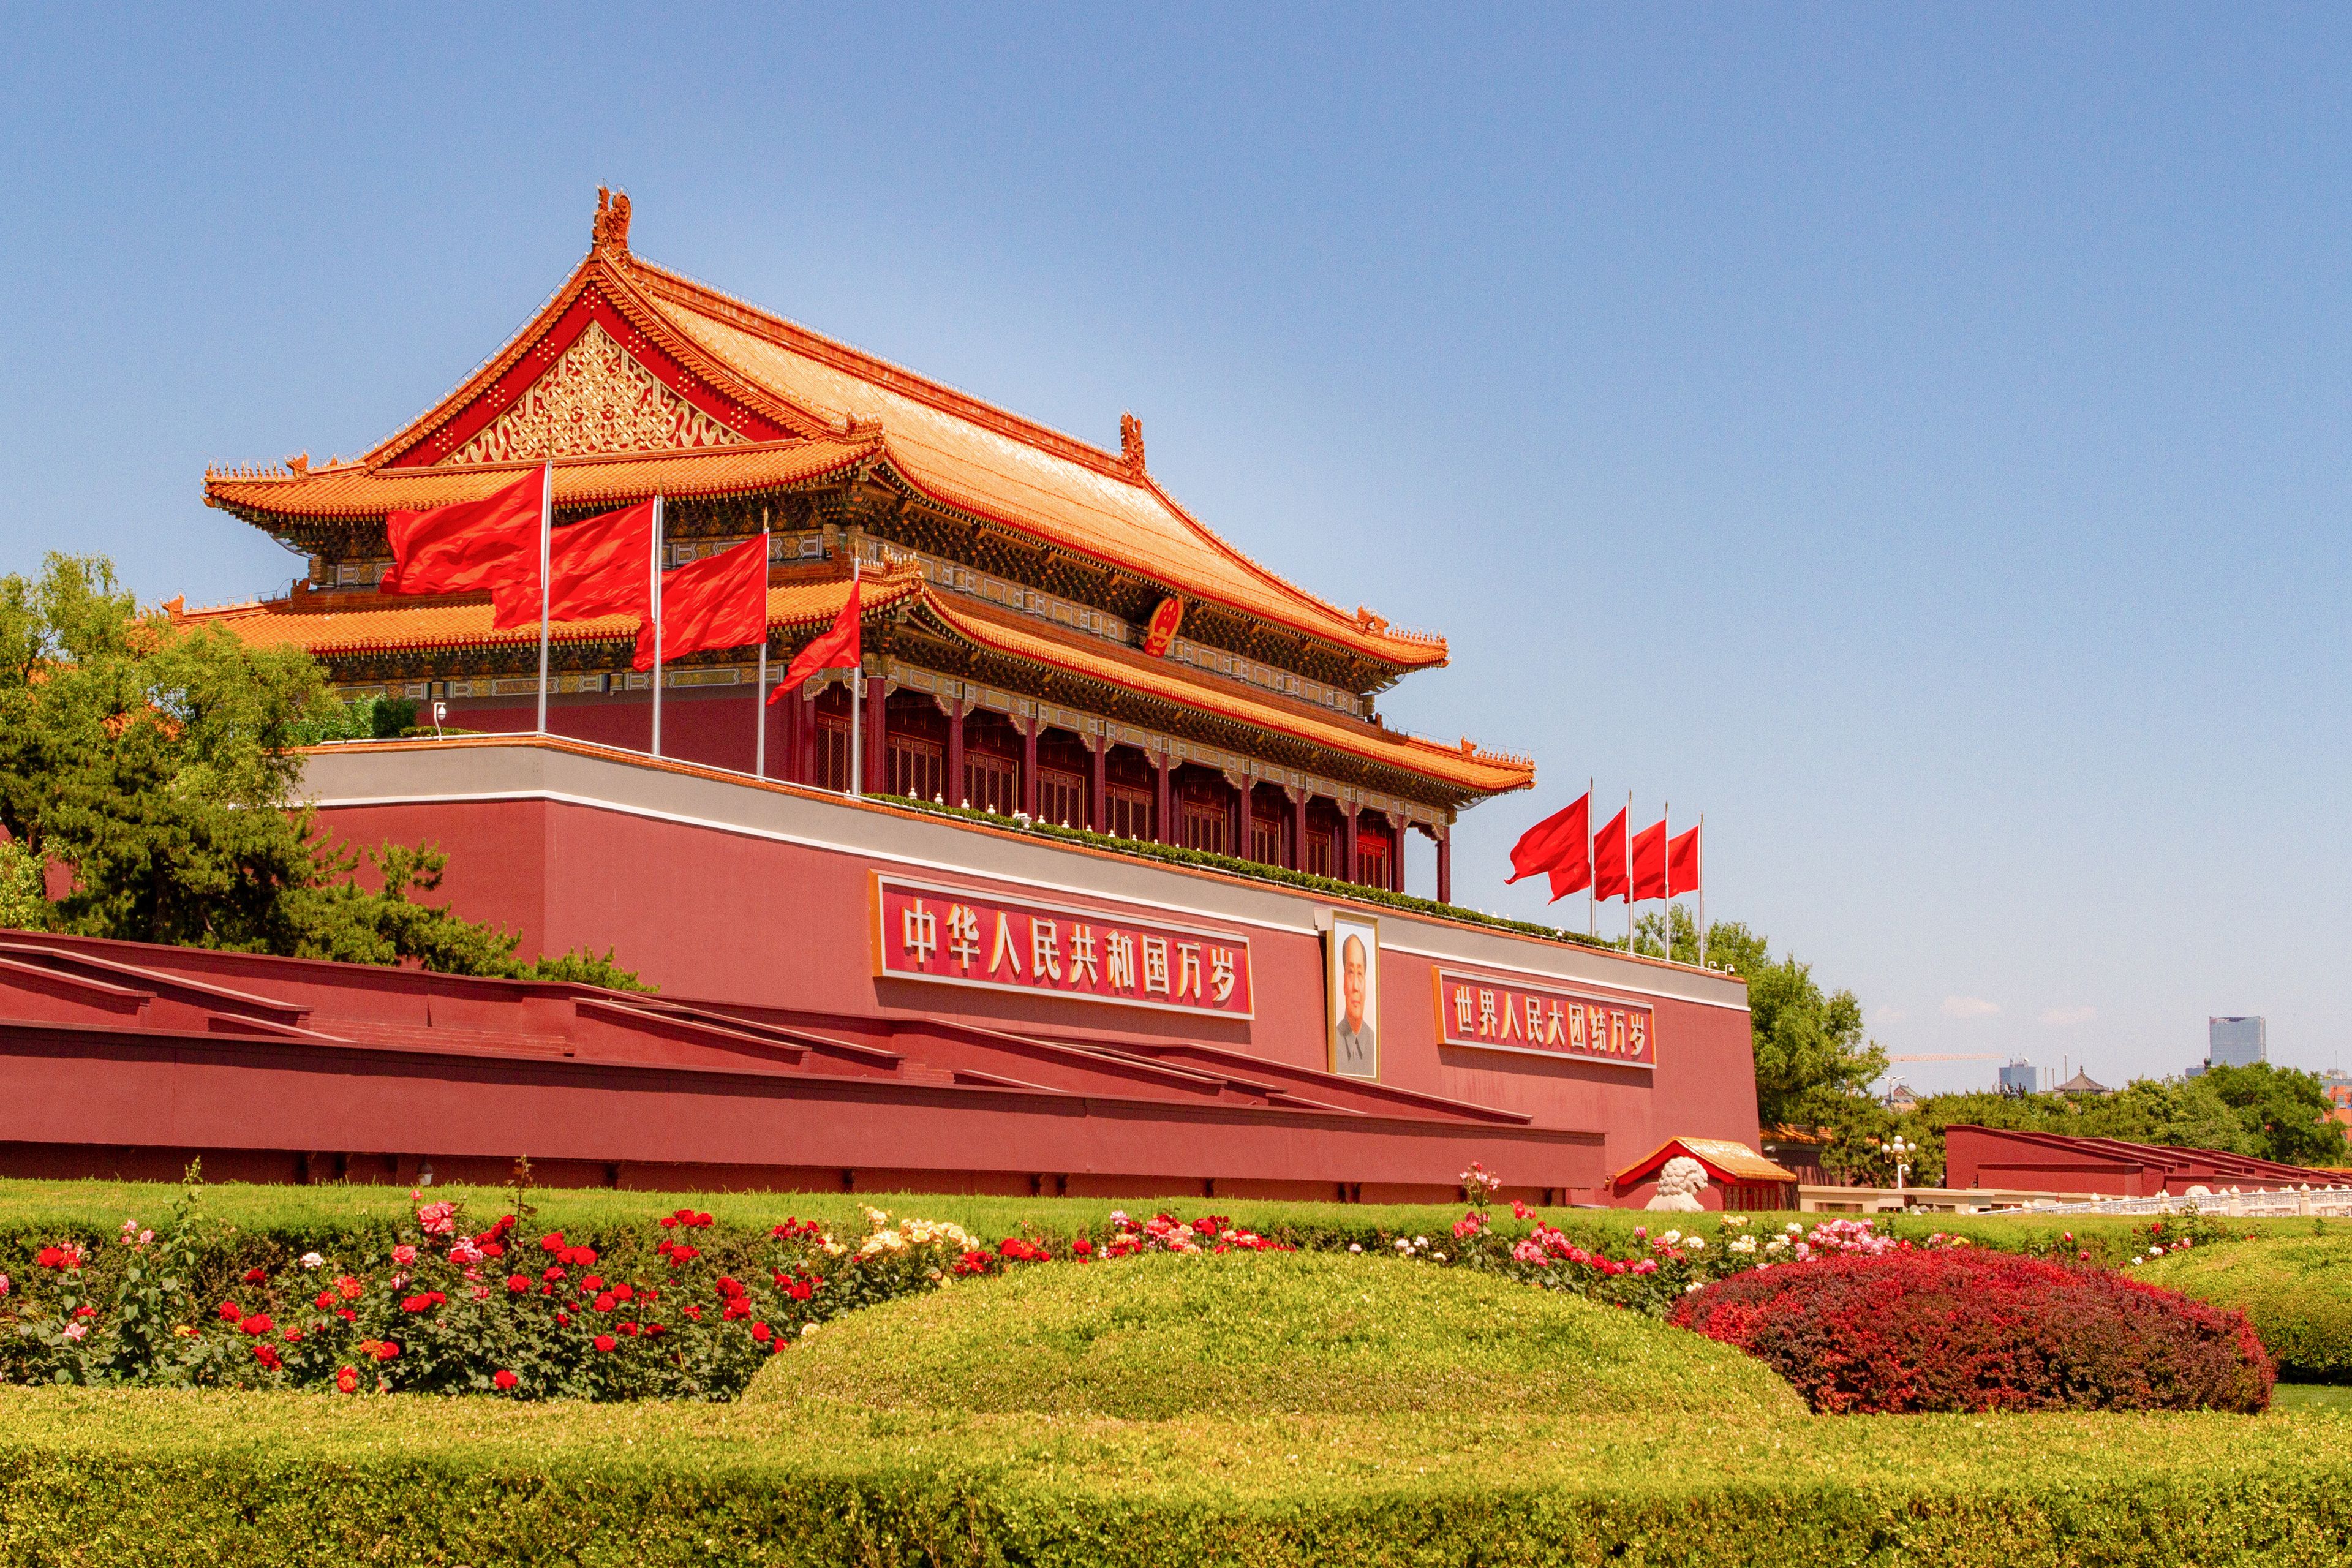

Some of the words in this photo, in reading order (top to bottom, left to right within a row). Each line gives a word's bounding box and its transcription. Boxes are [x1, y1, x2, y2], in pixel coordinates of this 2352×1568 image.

[902, 898, 1235, 1002] 中华人民共和国万岁
[1454, 984, 1646, 1055] 世界人民大团结万岁
